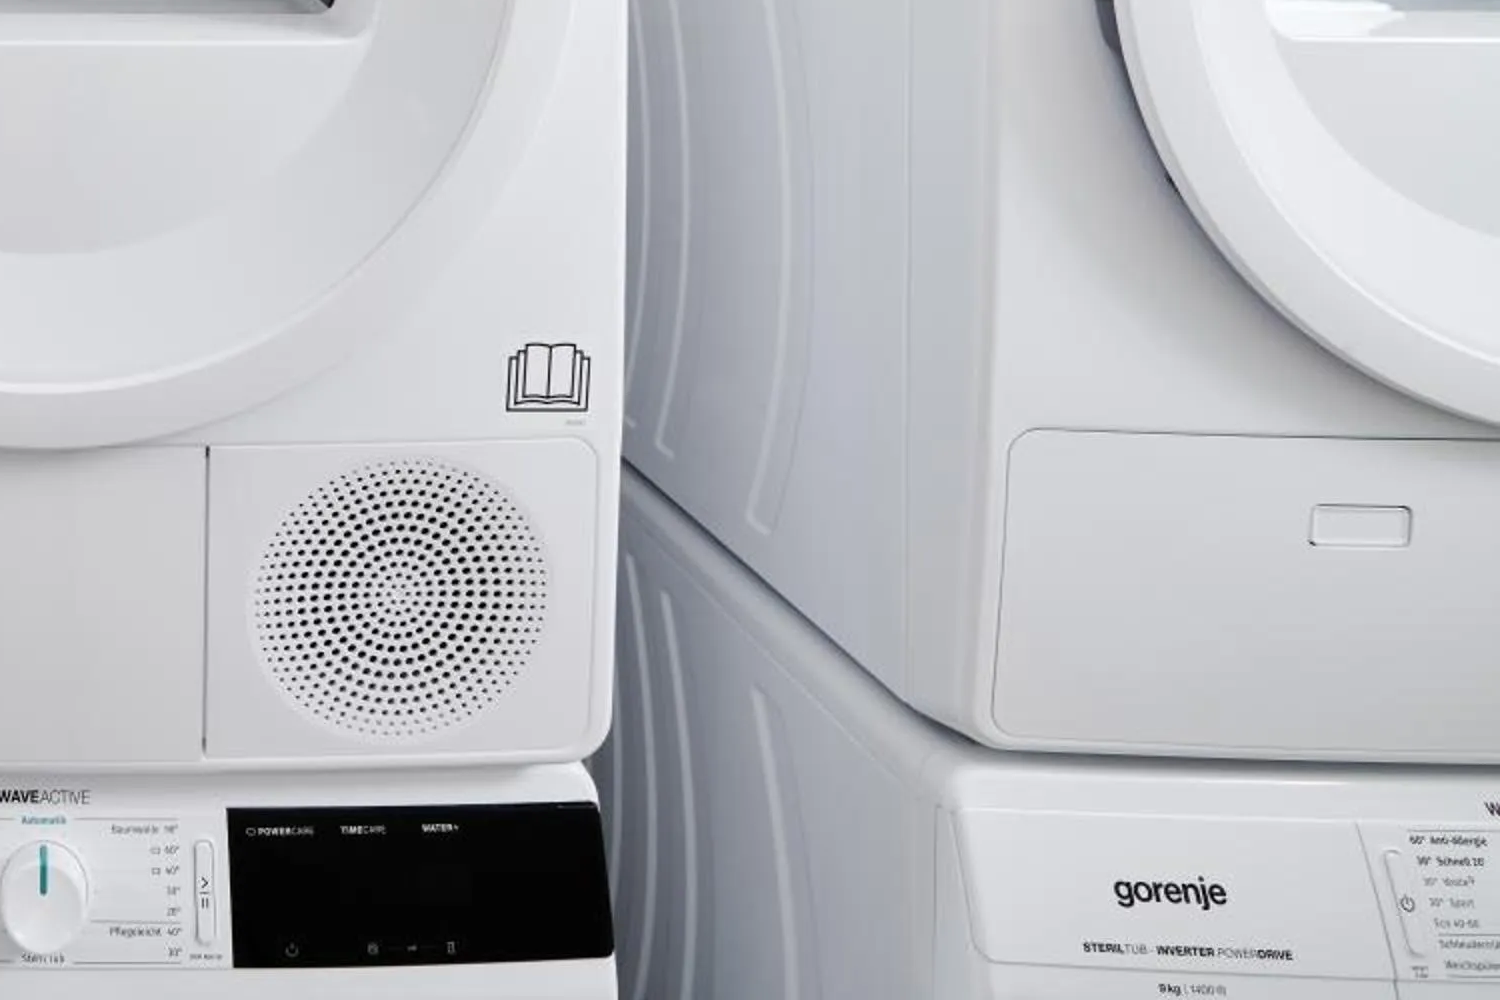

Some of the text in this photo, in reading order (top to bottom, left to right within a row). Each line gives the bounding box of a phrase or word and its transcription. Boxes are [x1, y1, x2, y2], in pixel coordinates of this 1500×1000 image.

[1113, 876, 1228, 911] gorenje
[1083, 942, 1293, 961] STERILTUB INVERTER POWERDRIVE
